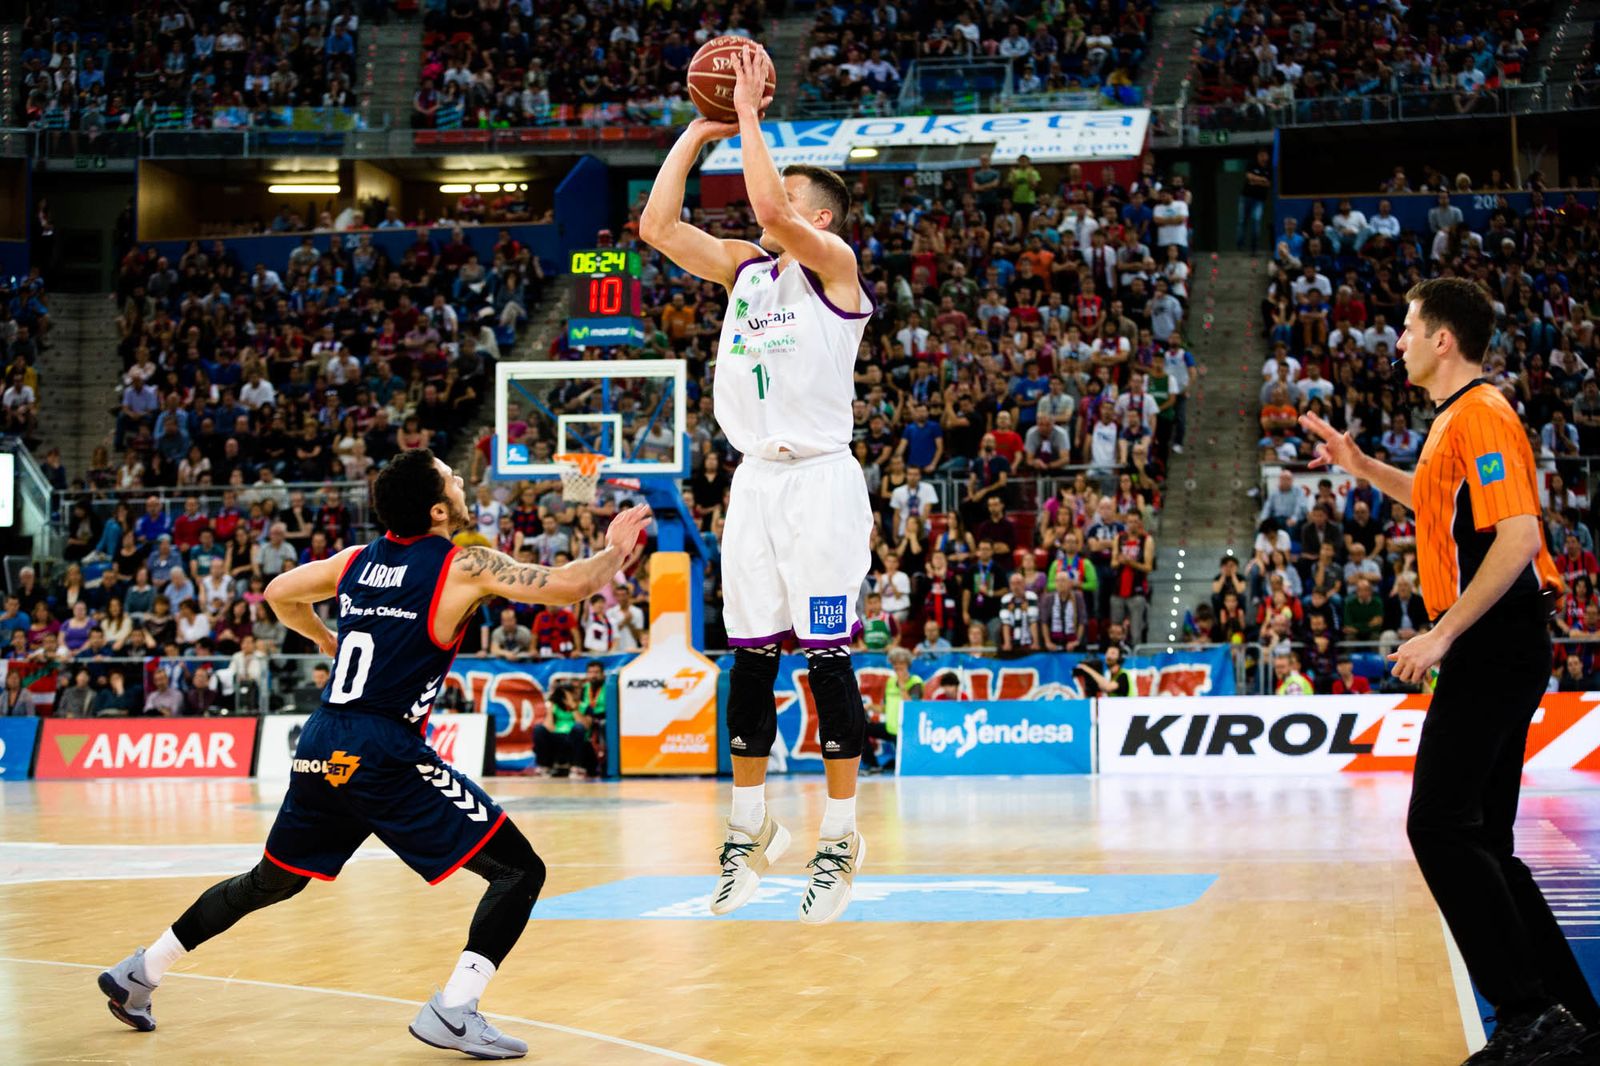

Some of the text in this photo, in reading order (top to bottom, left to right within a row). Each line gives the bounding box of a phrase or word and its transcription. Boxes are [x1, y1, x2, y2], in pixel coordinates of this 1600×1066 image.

[571, 252, 626, 273] 06:24
[589, 276, 623, 315] 10
[357, 561, 409, 588] LARKIN
[376, 606, 418, 620] Children
[328, 630, 376, 705] 0
[83, 733, 240, 769] AMBAR
[1119, 708, 1540, 758] KIROLB
